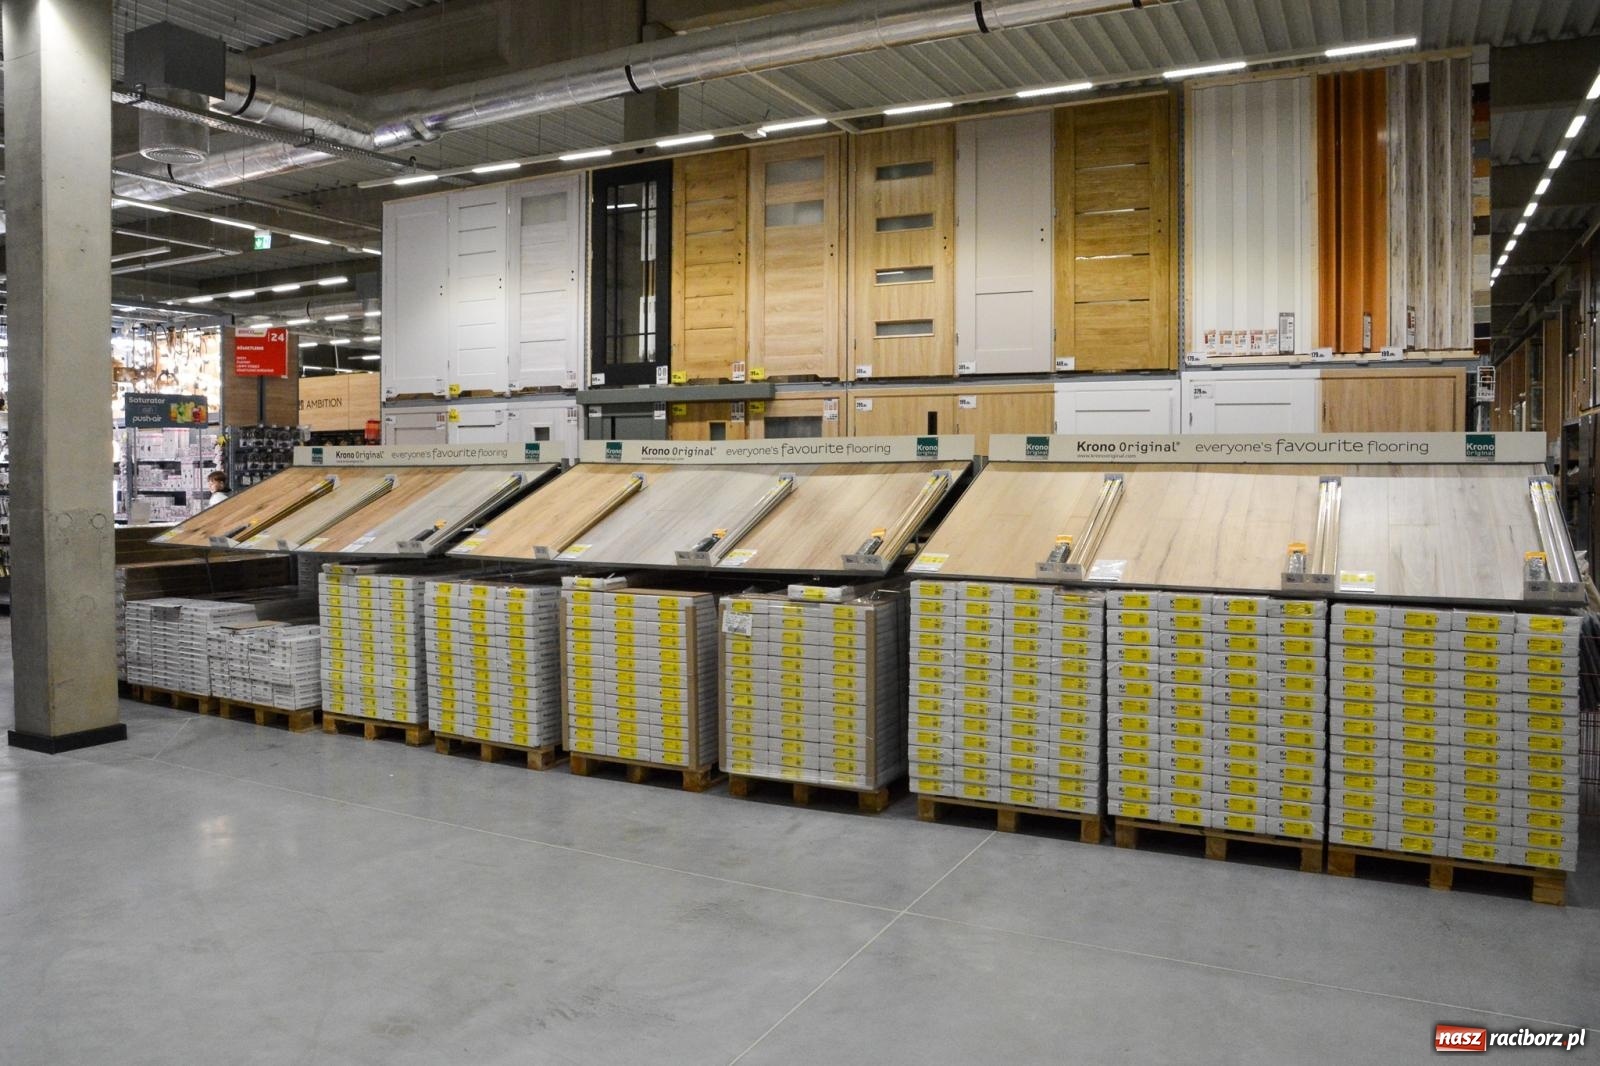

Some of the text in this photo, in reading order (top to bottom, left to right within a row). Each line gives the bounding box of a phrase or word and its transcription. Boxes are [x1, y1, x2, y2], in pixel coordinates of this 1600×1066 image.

[271, 333, 285, 342] 24
[306, 397, 343, 409] AMBITION
[641, 443, 891, 458] Krono Original everyone's favourite flooring
[1077, 438, 1429, 455] Krono Original everyone's favourite flooring
[392, 450, 431, 460] everyone's
[432, 448, 476, 459] favourite
[478, 448, 508, 459] flooring
